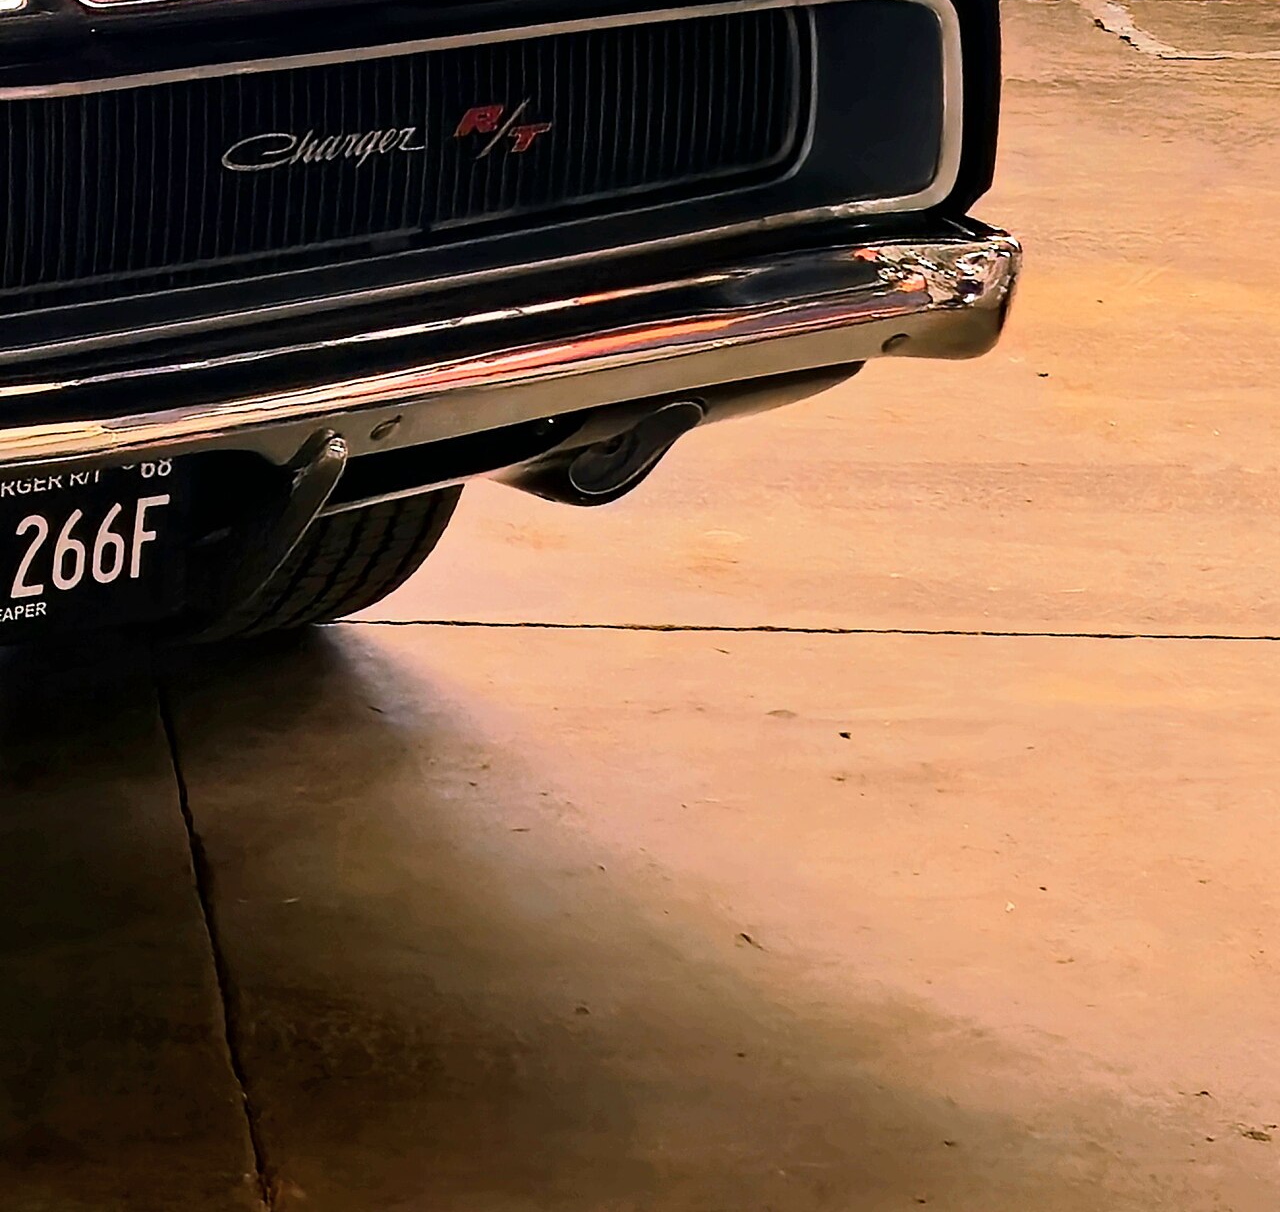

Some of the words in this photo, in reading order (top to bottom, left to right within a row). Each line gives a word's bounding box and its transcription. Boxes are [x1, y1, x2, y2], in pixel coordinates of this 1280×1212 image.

[221, 126, 427, 172] Charger
[452, 97, 553, 160] R/T
[10, 493, 171, 599] 266F
